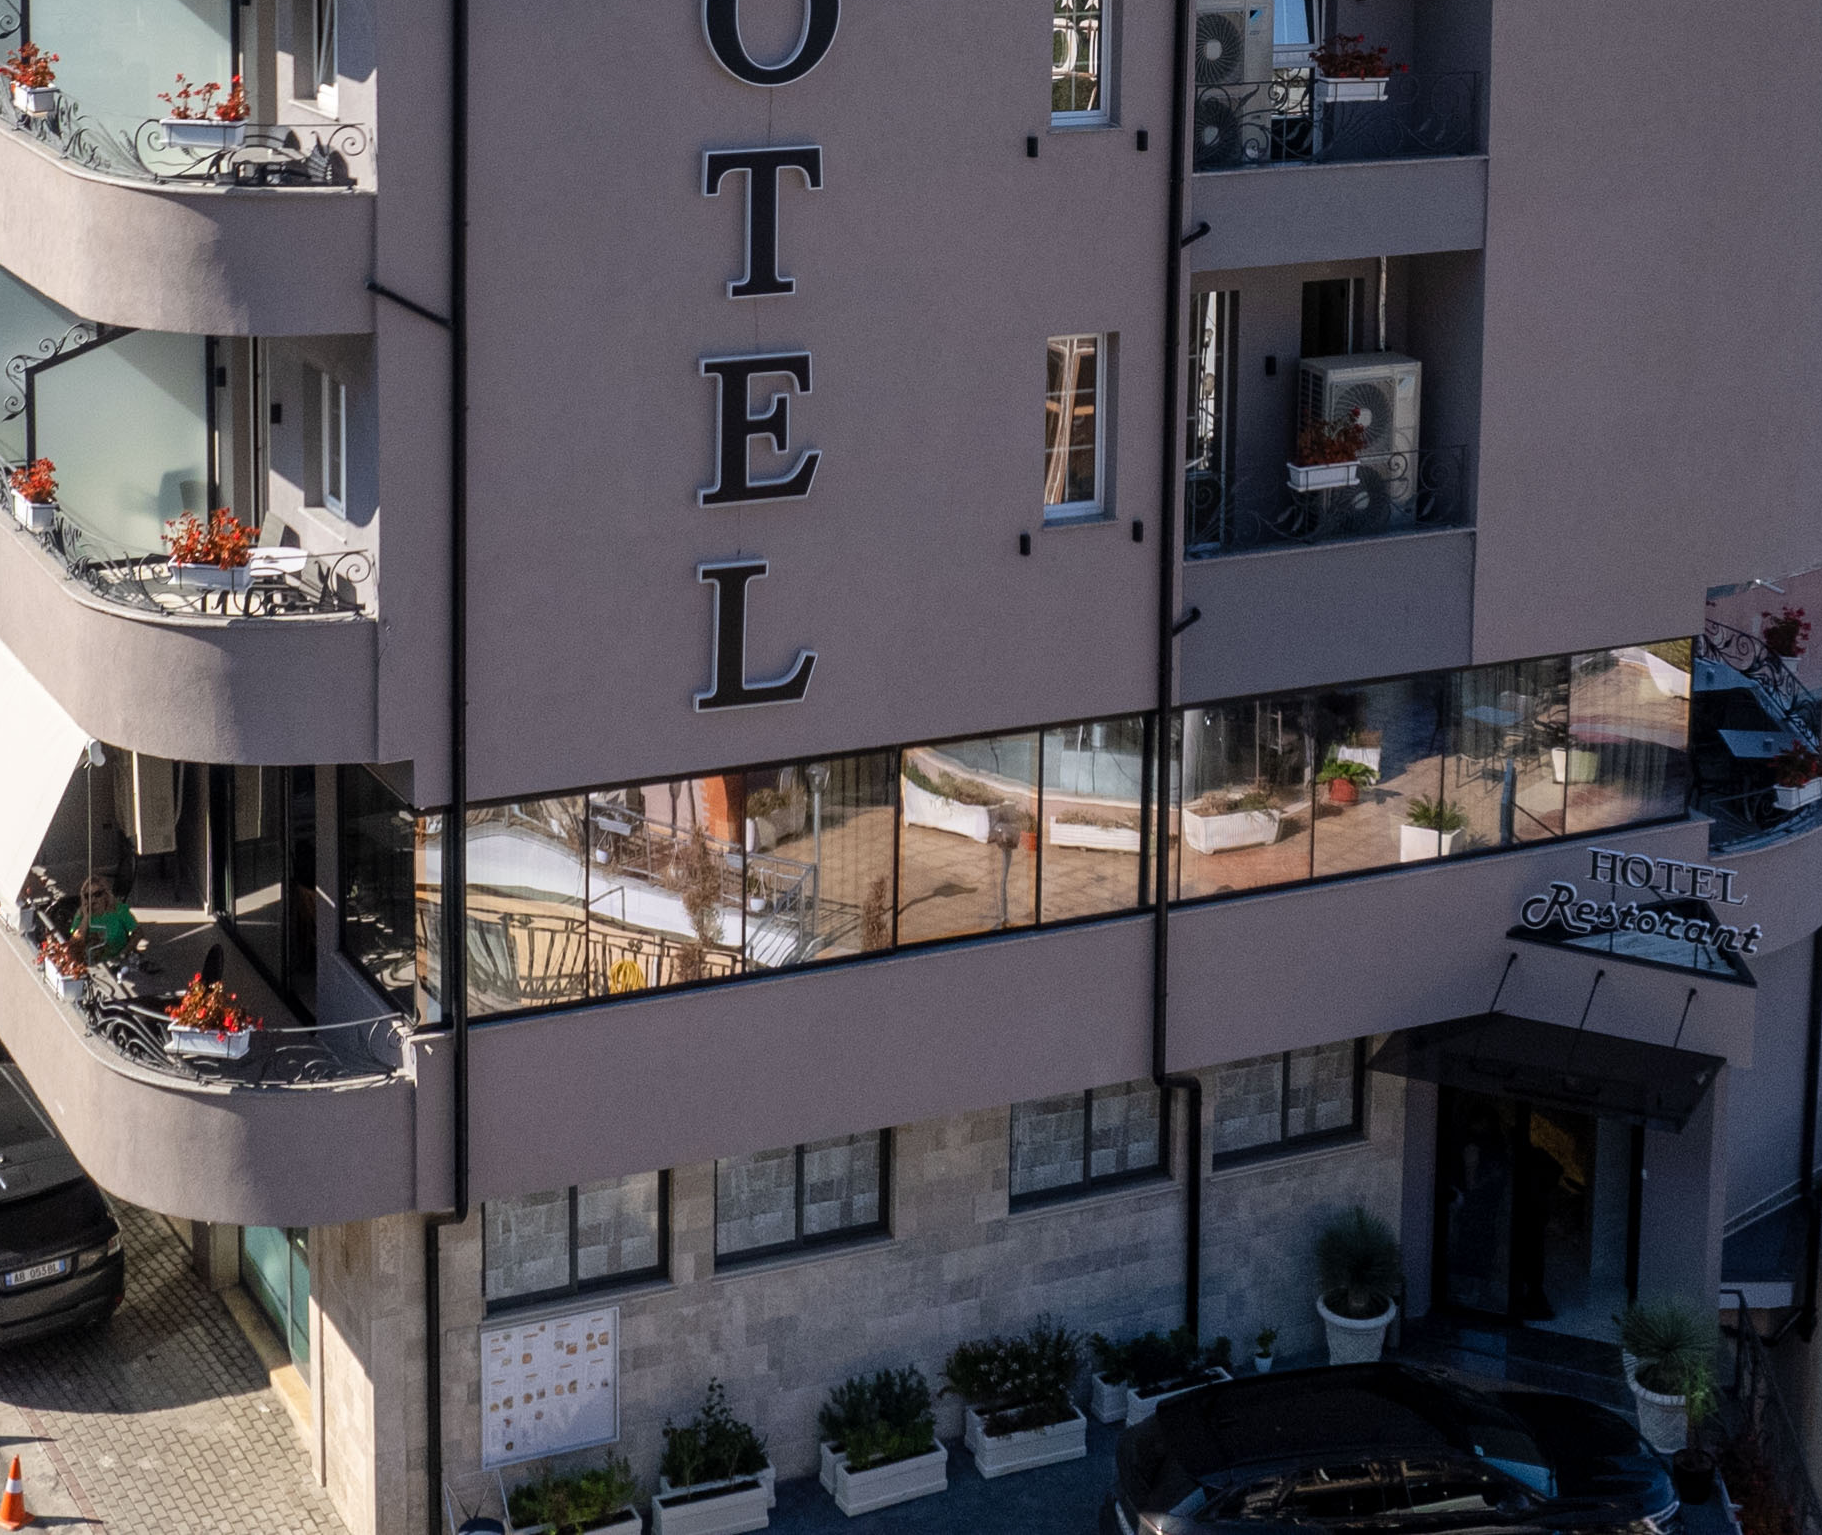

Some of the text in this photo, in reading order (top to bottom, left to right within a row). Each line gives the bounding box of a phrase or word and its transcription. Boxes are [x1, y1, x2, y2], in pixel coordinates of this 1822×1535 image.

[1587, 847, 1748, 906] HOTEL
[1520, 881, 1763, 955] Restorant
[14, 1272, 25, 1283] AB
